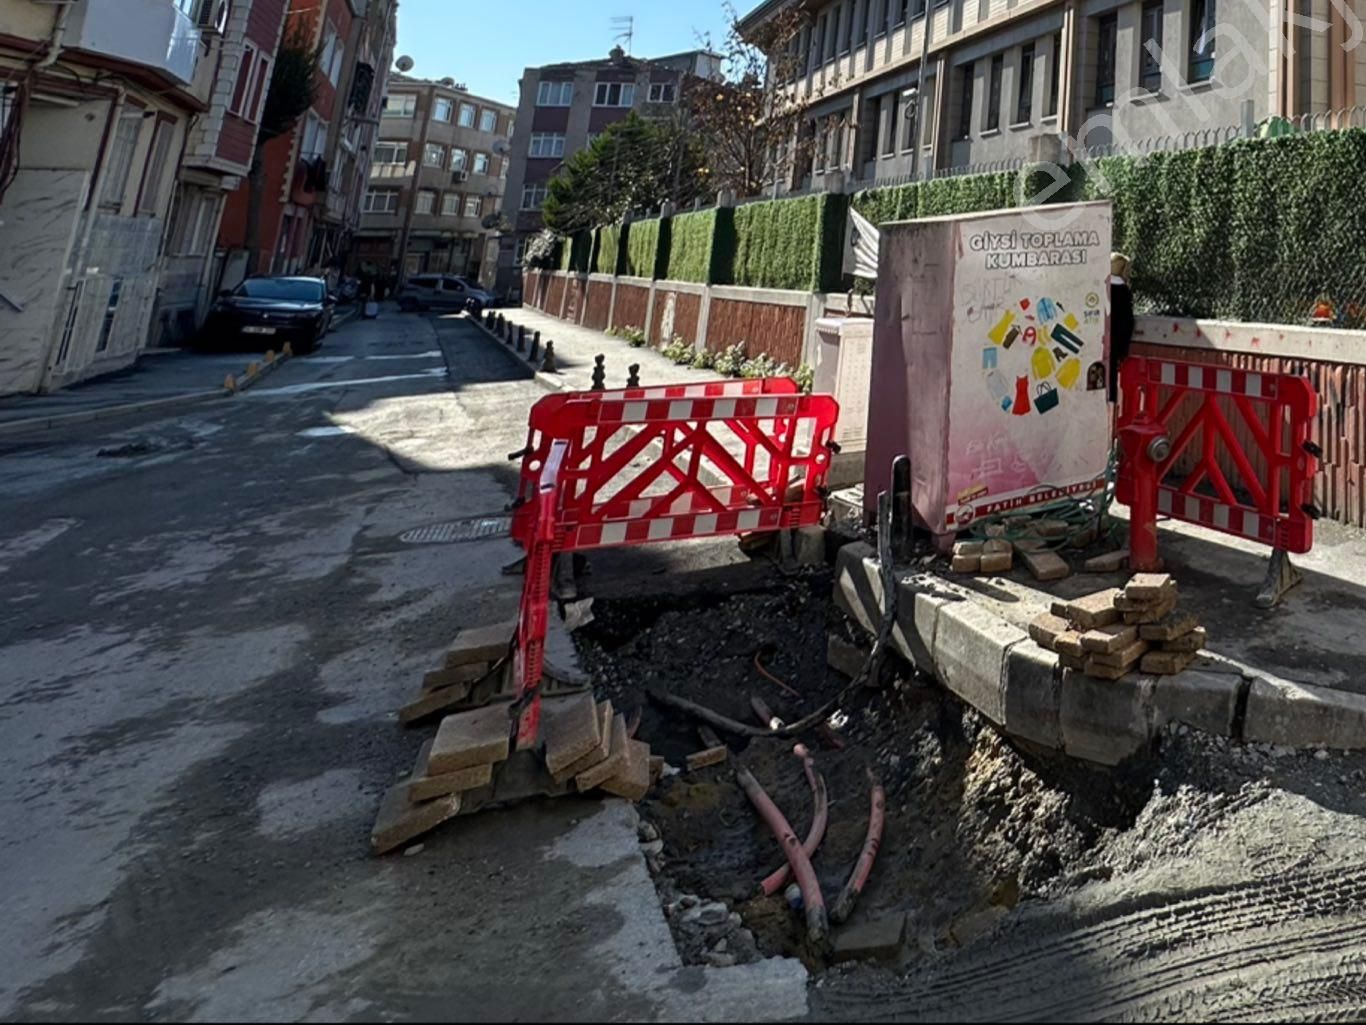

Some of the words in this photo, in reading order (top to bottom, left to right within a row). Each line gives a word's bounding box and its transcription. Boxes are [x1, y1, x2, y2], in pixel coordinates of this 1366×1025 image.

[970, 229, 1017, 251] GİYSİ
[1020, 230, 1100, 250] TOPLAMA
[985, 249, 1088, 270] KUMBARASI
